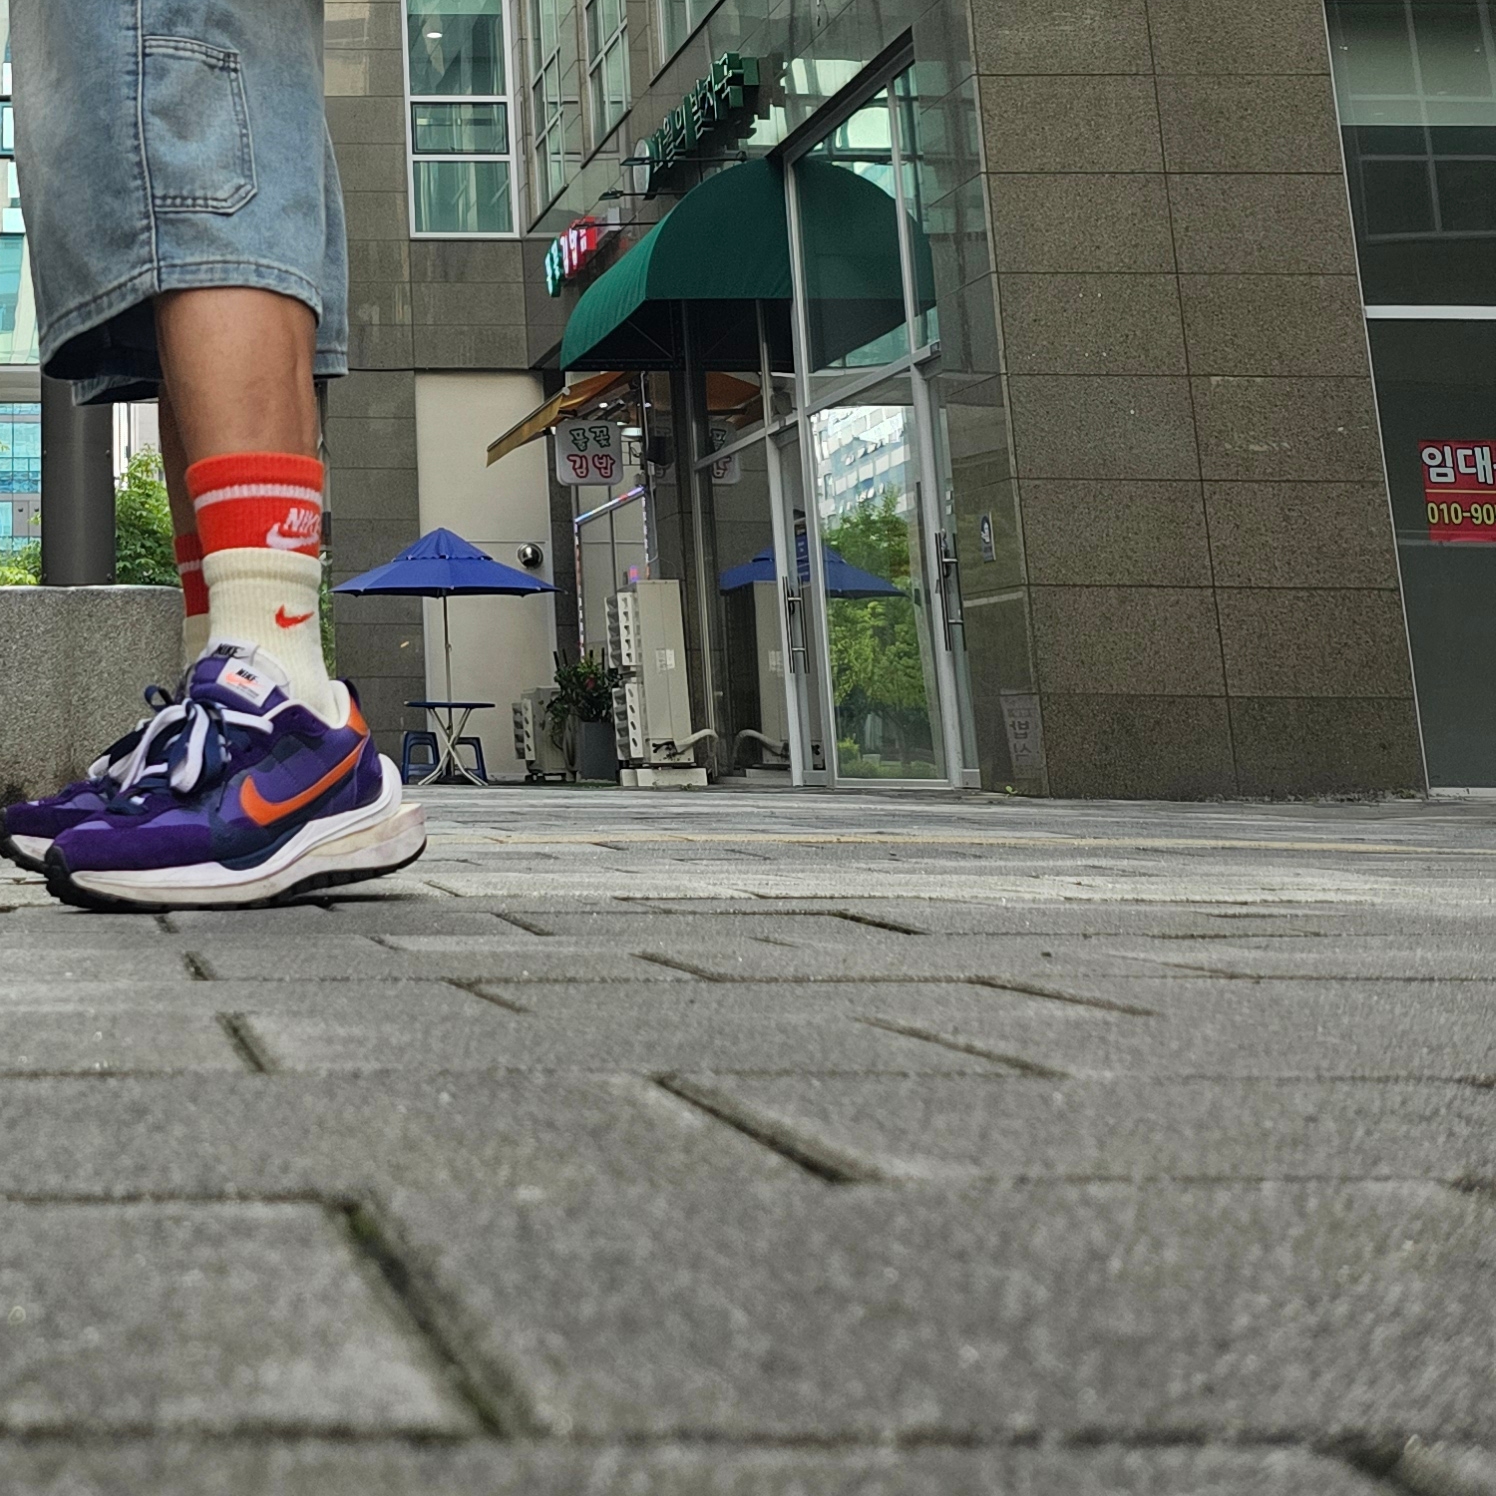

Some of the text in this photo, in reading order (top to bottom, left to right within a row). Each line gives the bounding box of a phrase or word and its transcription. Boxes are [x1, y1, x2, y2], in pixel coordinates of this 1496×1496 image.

[567, 454, 616, 479] 김밥
[1421, 445, 1496, 484] 임대
[1427, 502, 1496, 525] 010-90
